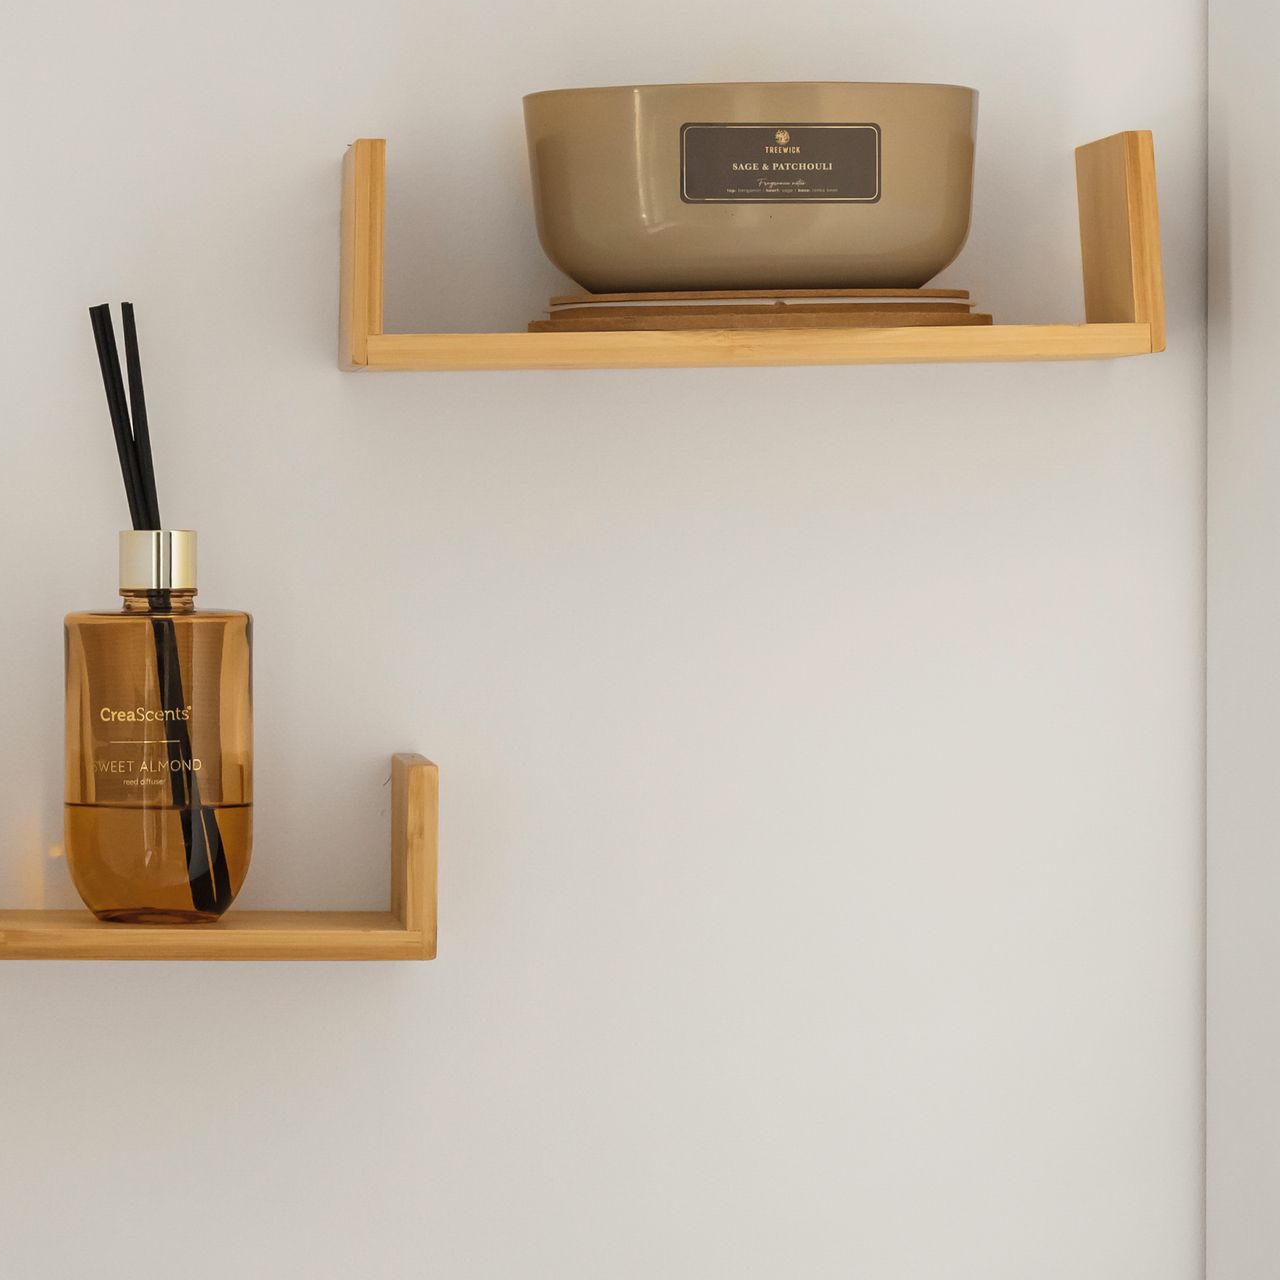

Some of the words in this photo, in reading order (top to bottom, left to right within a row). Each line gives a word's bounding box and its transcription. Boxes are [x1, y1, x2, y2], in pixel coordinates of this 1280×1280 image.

[765, 146, 801, 154] TREEWICK
[732, 162, 759, 171] SAGE
[762, 162, 769, 171] &
[772, 162, 833, 171] PATCHOULI
[139, 757, 202, 773] ALMOND
[123, 778, 139, 786] reed
